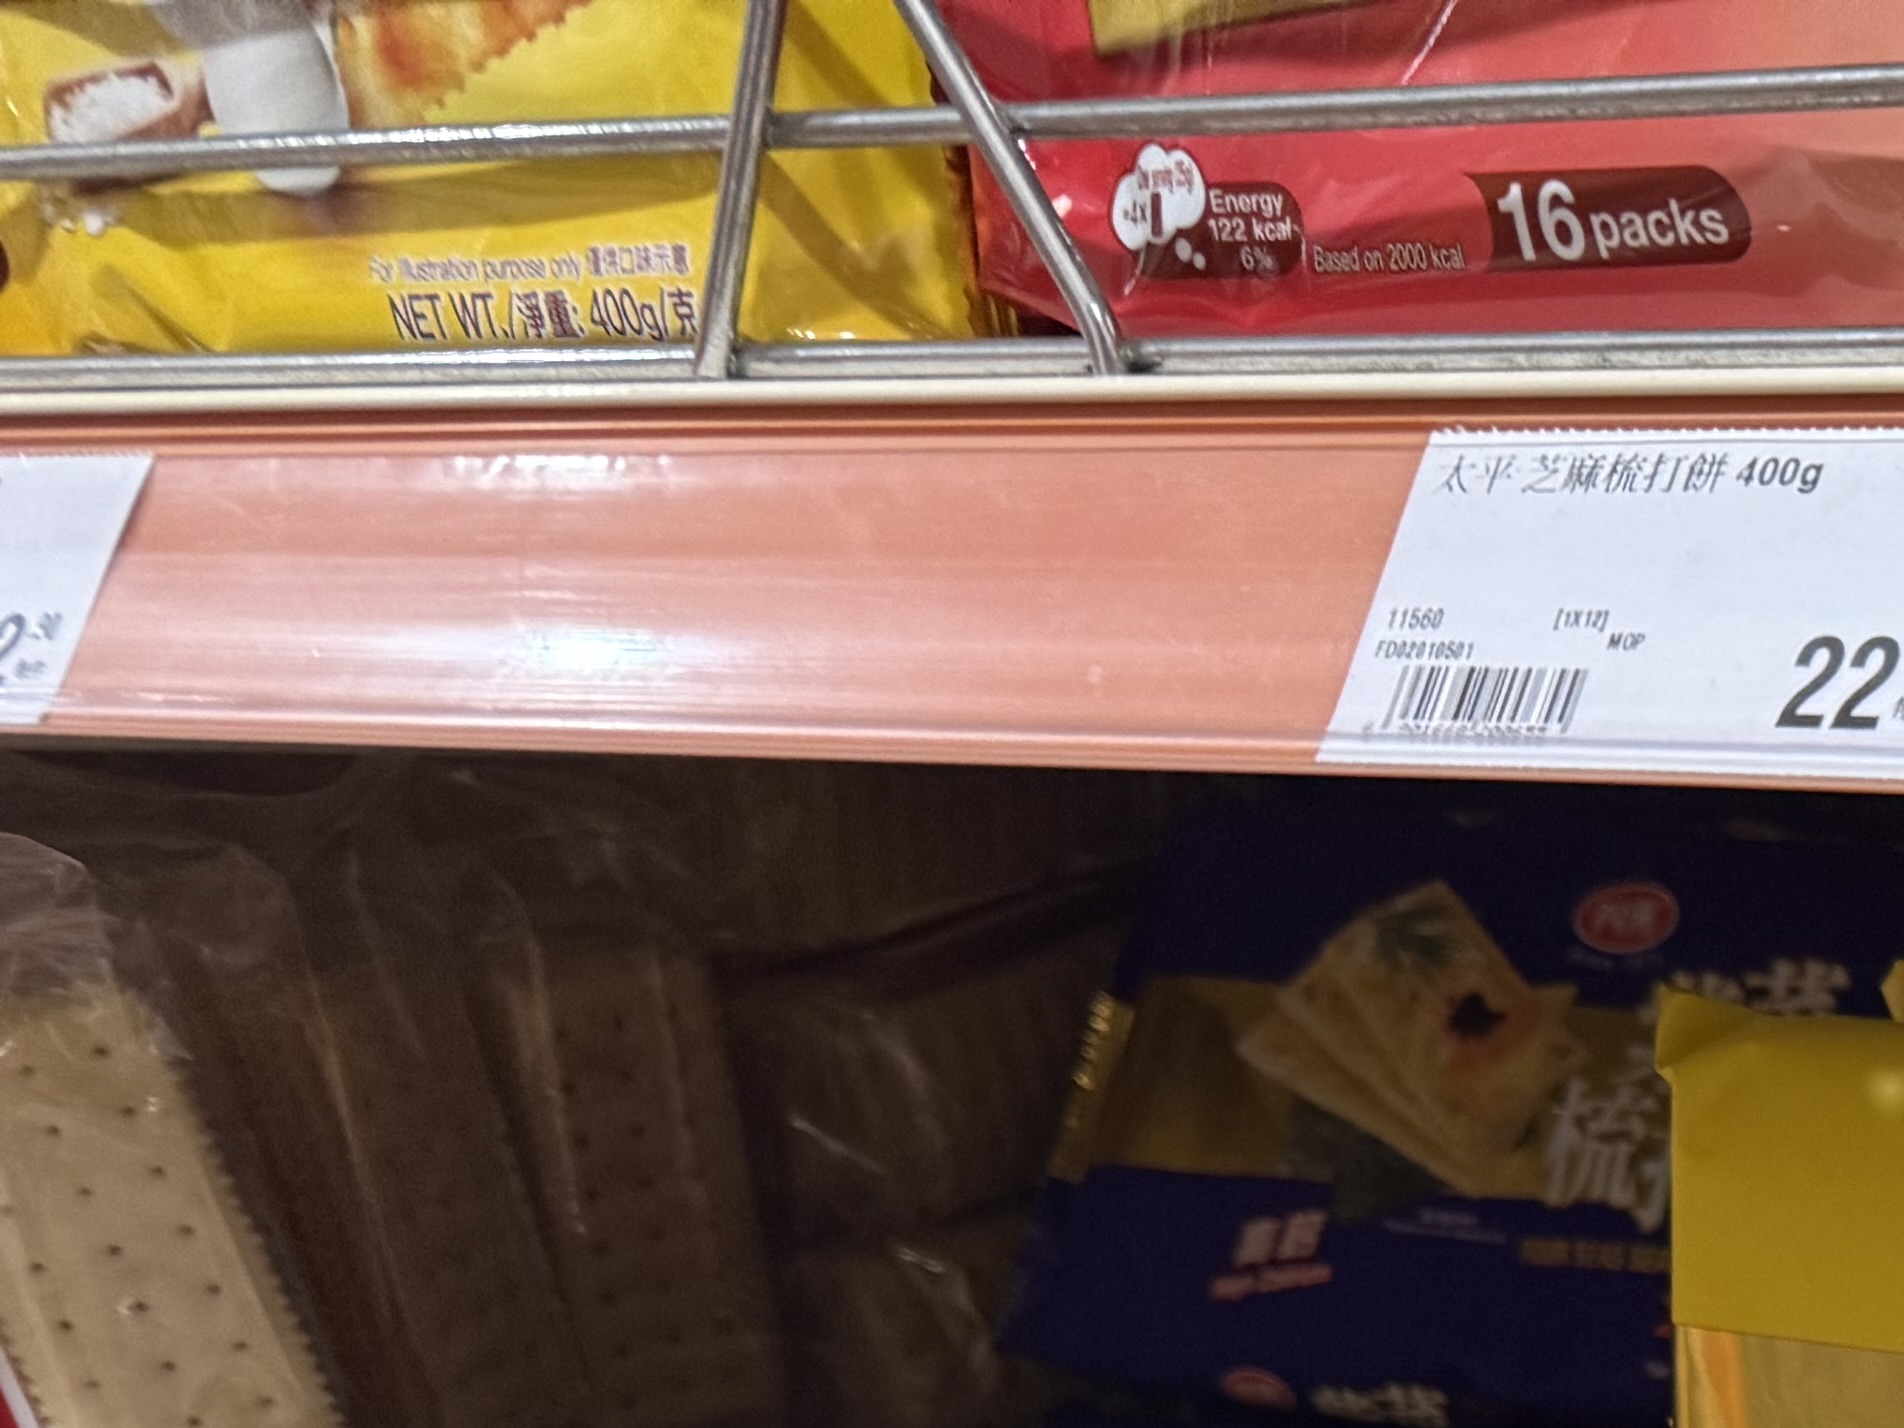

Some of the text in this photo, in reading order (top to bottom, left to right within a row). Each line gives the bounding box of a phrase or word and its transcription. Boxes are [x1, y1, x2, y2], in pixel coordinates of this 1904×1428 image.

[1208, 188, 1283, 218] Energy
[1207, 215, 1292, 242] 122 kcal
[1498, 179, 1731, 263] 16 packs
[1313, 242, 1467, 274] Based on 2000 kcal
[387, 291, 448, 341] NET
[1437, 450, 1825, 495] 太平 芝麻梳打餅 400g
[1387, 607, 1445, 631] 11560
[1605, 631, 1646, 651] MOP
[1774, 634, 1901, 731] 22
